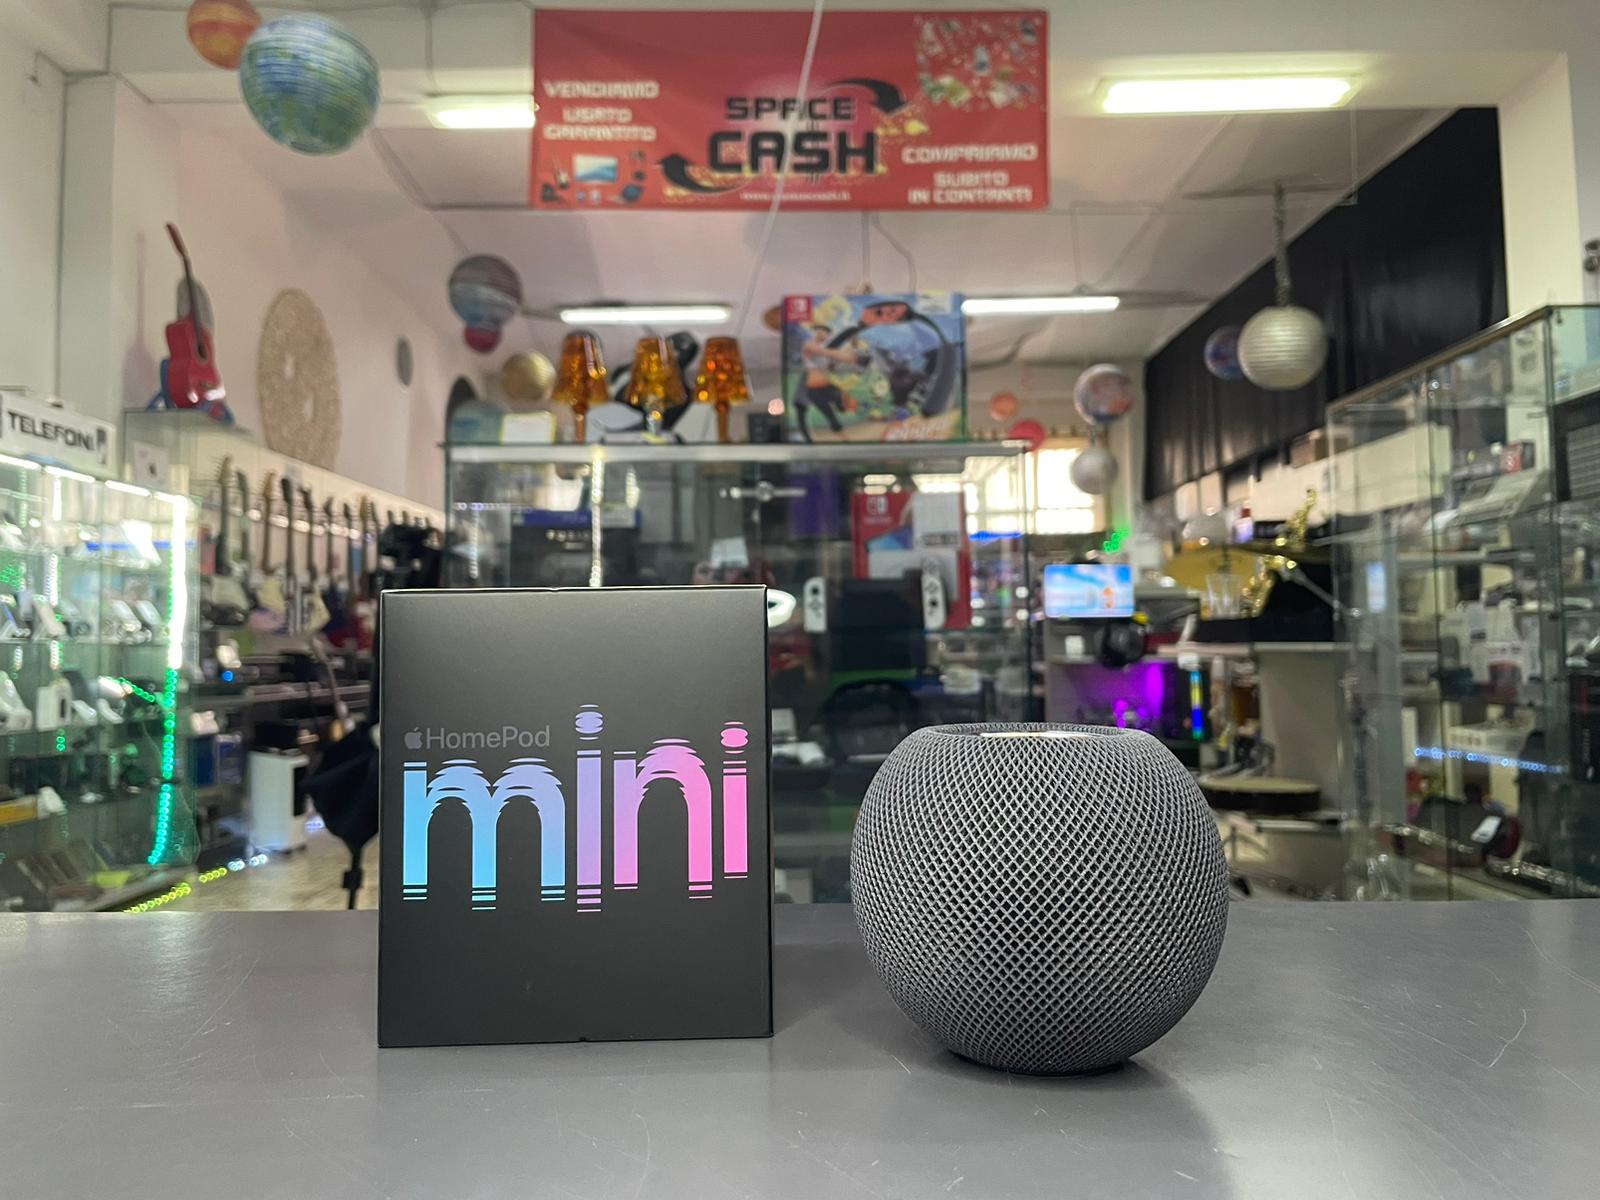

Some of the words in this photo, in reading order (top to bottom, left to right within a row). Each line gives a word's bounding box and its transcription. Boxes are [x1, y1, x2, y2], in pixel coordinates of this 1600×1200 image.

[542, 80, 660, 99] VENDIAMO
[727, 97, 854, 121] SPACE
[543, 124, 657, 141] GARANTITO
[709, 131, 876, 174] CASH
[901, 142, 1038, 164] COMPRIAMO
[934, 171, 1009, 187] SUBITO
[907, 188, 931, 204] IN
[932, 185, 1033, 203] CONTANTI
[8, 411, 96, 451] TELEFONI
[426, 725, 550, 749] HomePod
[403, 704, 748, 913] mini
